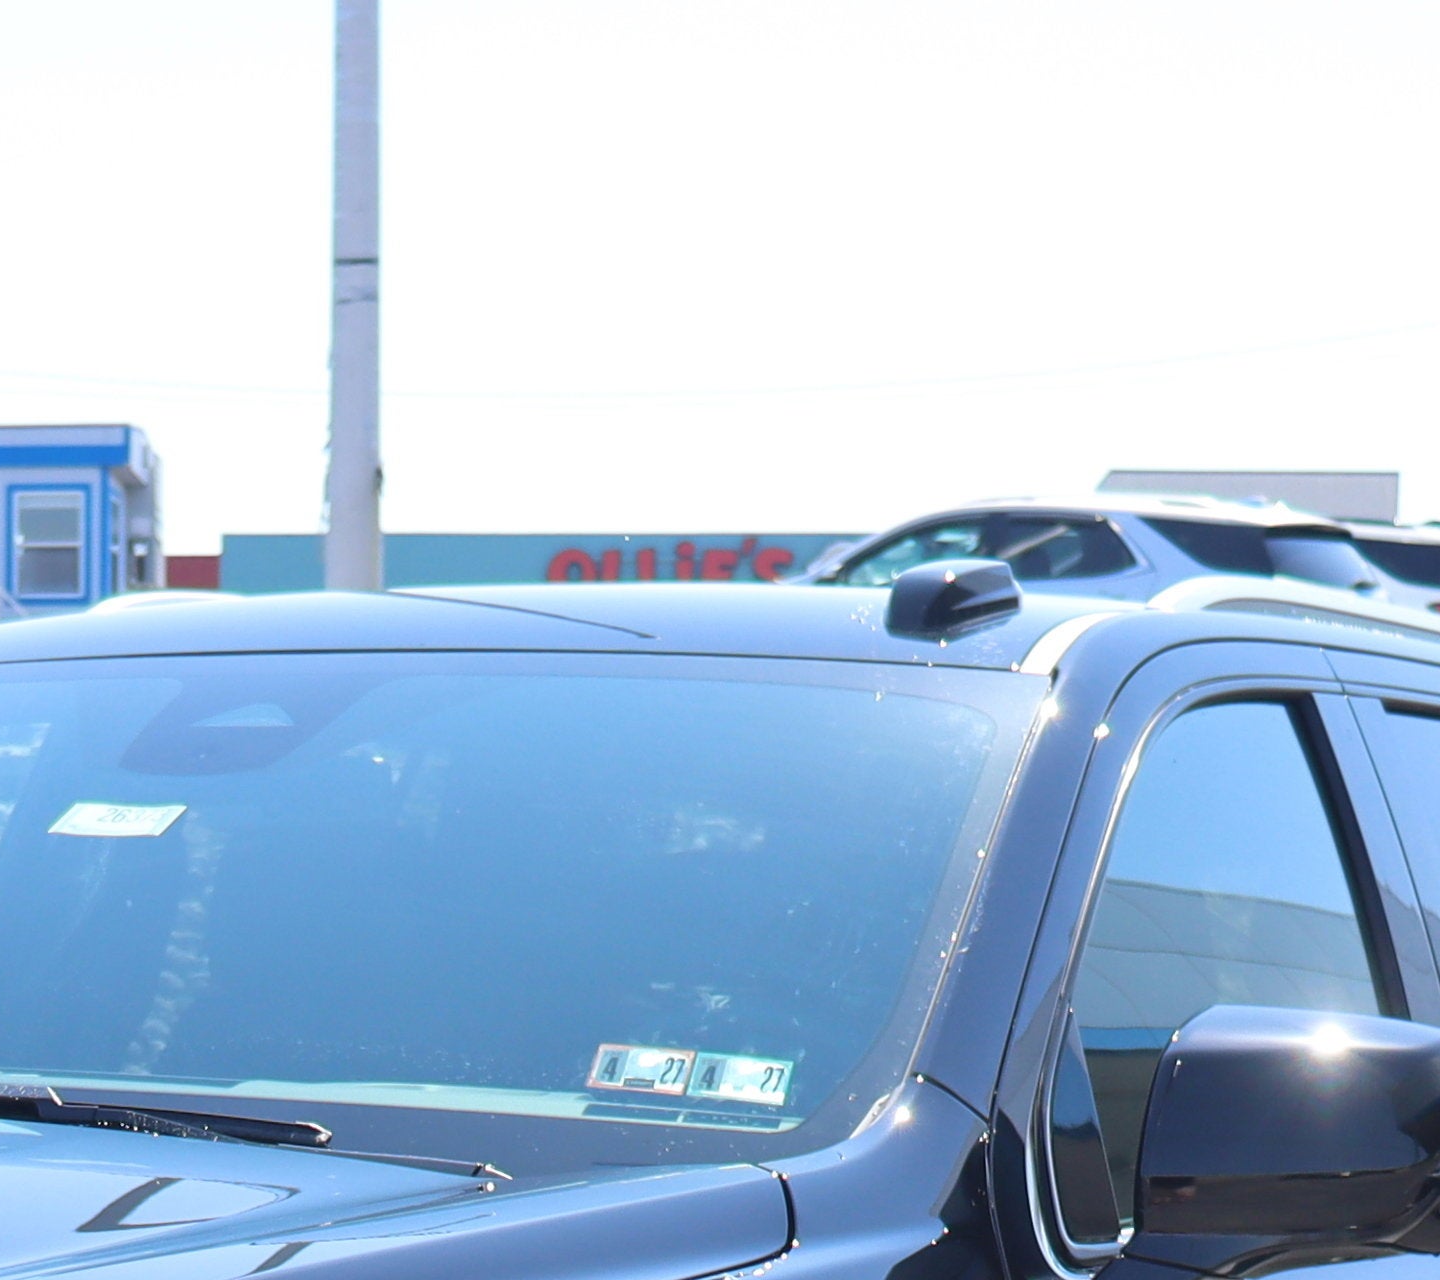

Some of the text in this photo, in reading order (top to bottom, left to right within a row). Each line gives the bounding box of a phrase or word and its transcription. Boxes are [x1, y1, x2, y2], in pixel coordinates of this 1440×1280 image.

[602, 1056, 686, 1086] 4 27
[700, 1065, 785, 1093] 4 27
